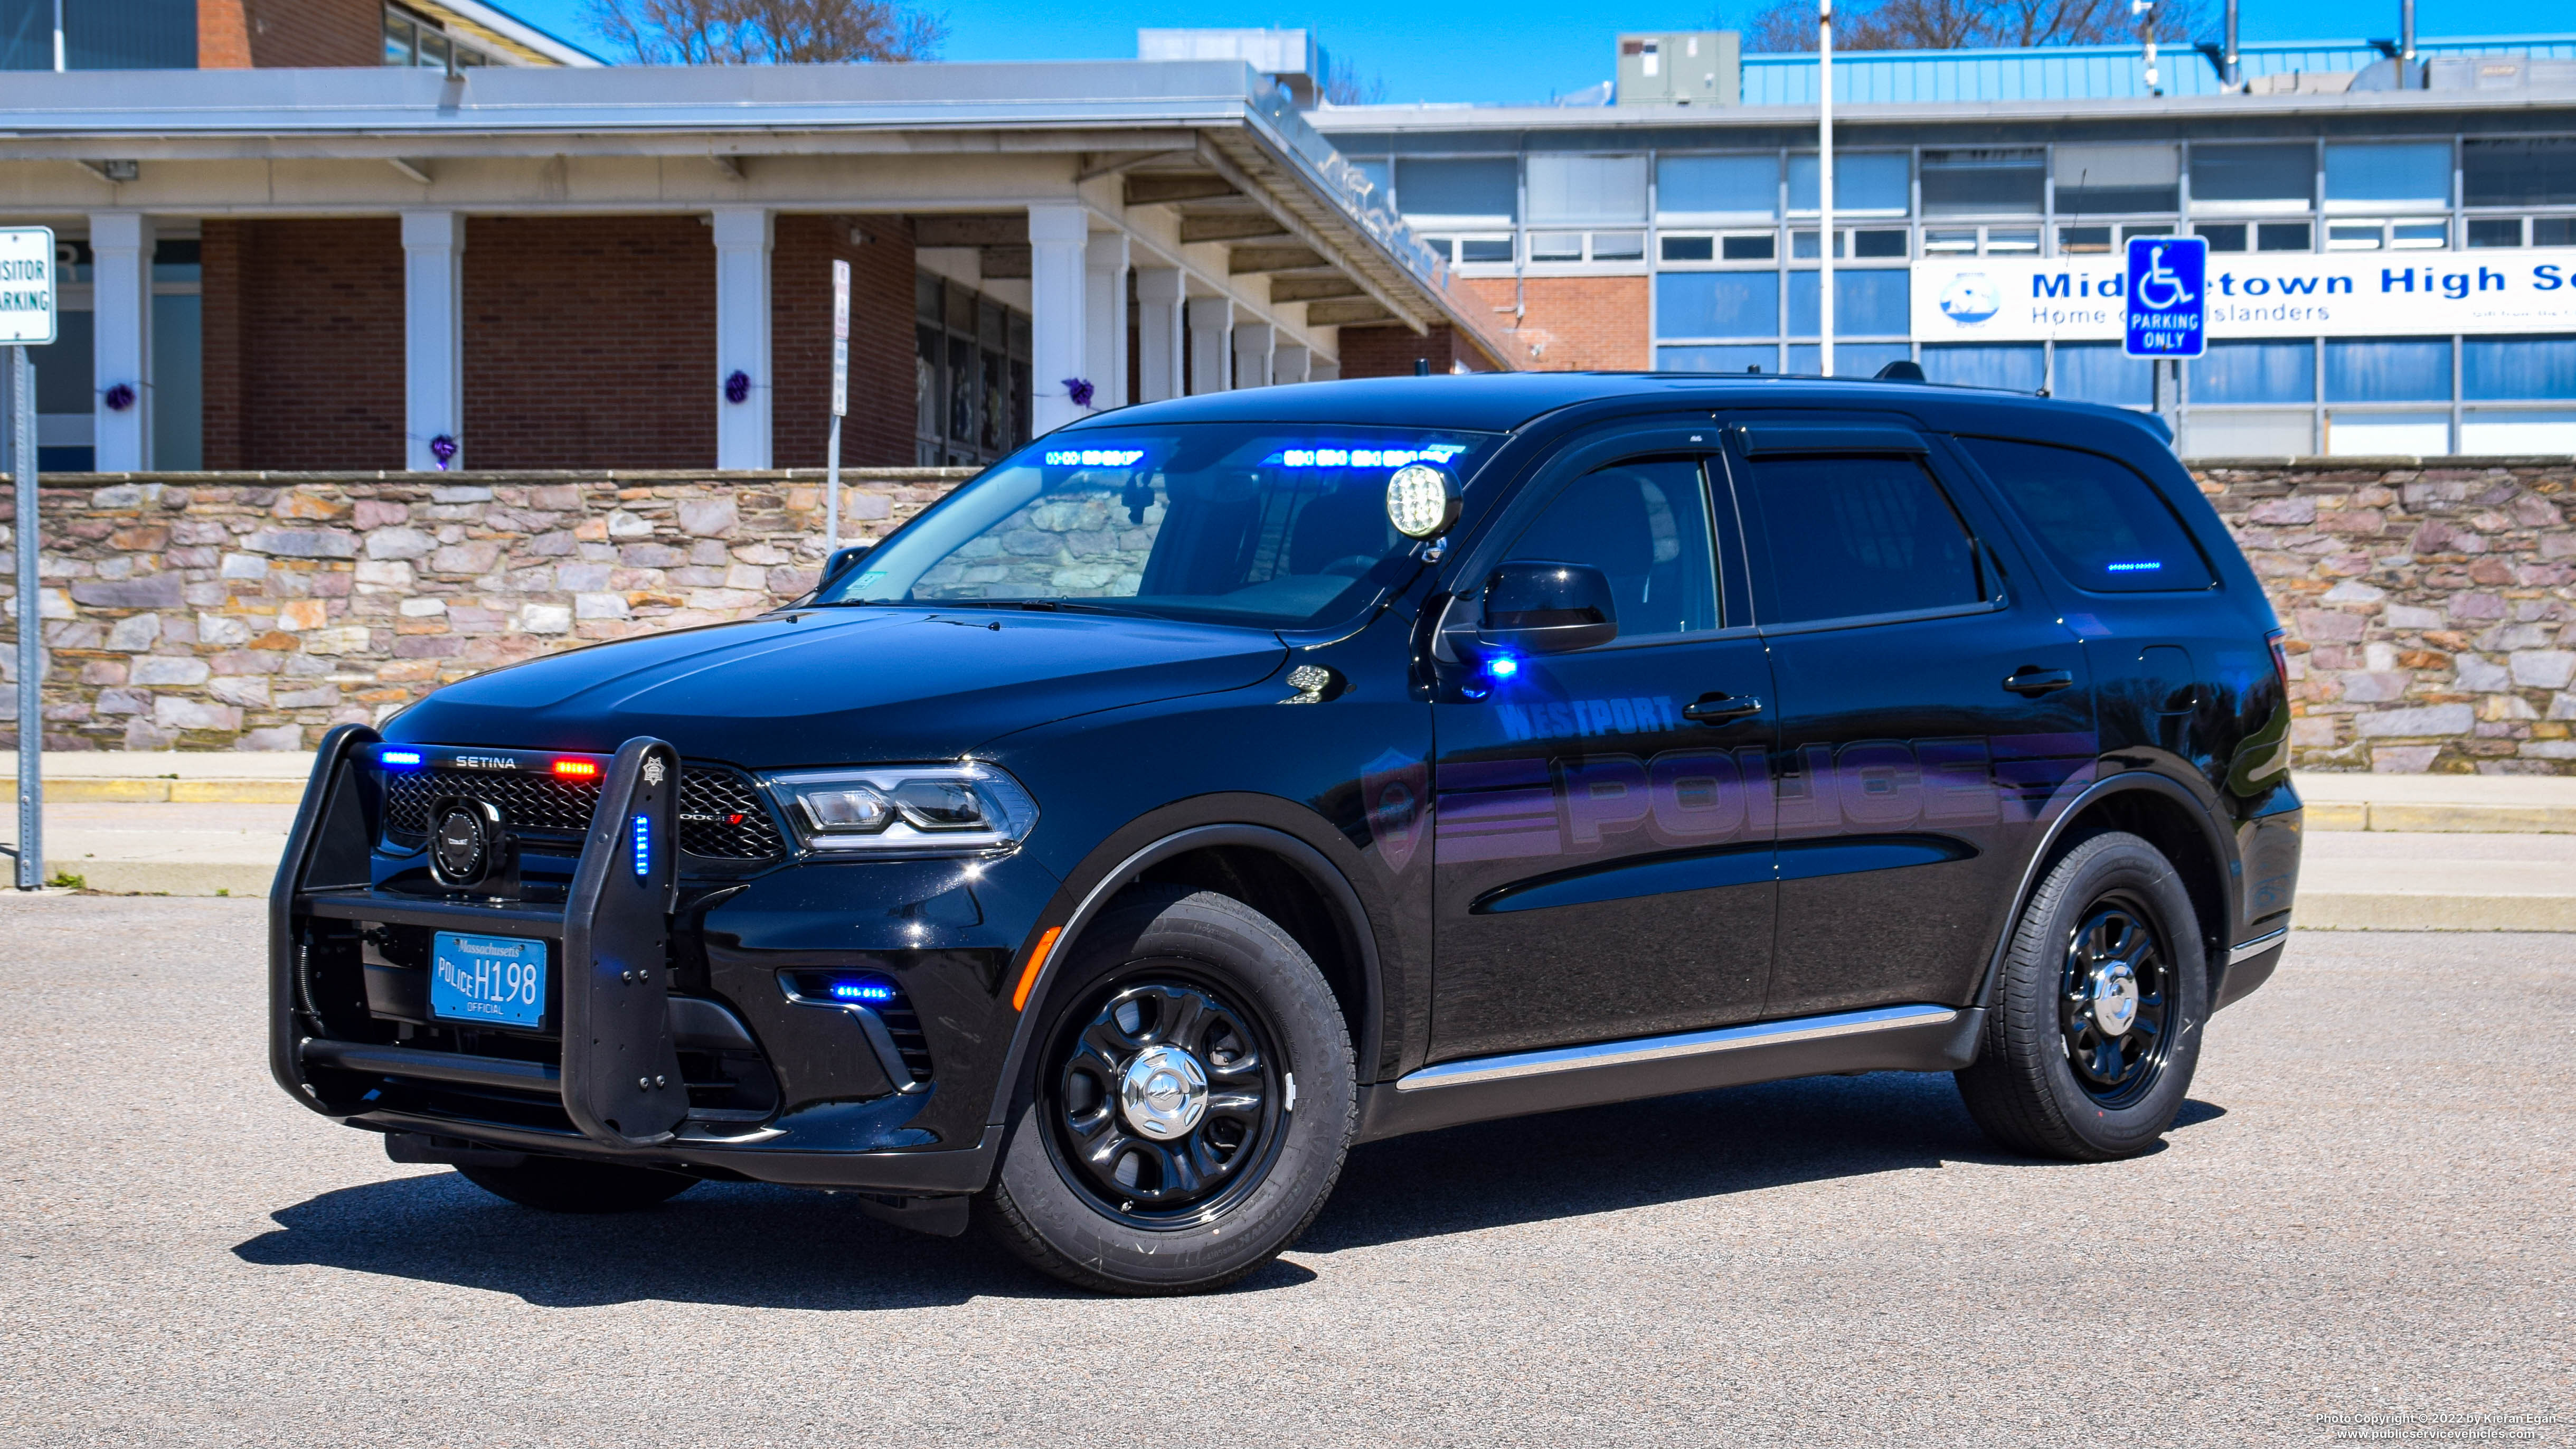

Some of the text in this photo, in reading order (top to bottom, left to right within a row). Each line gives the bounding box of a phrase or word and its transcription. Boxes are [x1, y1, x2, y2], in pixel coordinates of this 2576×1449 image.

[2032, 265, 2576, 299] Midtown High S
[0, 290, 49, 311] RKING
[2032, 306, 2106, 324] Home
[2205, 303, 2330, 322] Islanders
[2130, 313, 2198, 330] PARKING
[2143, 332, 2185, 349] ONLY
[1495, 696, 1676, 740] WESTPORT
[456, 756, 516, 769] SETINA
[1550, 736, 2004, 855] POLICE
[458, 939, 520, 958] Massachusetts
[438, 956, 537, 1005] POLICE H198
[467, 1002, 504, 1015] OFFICIAL
